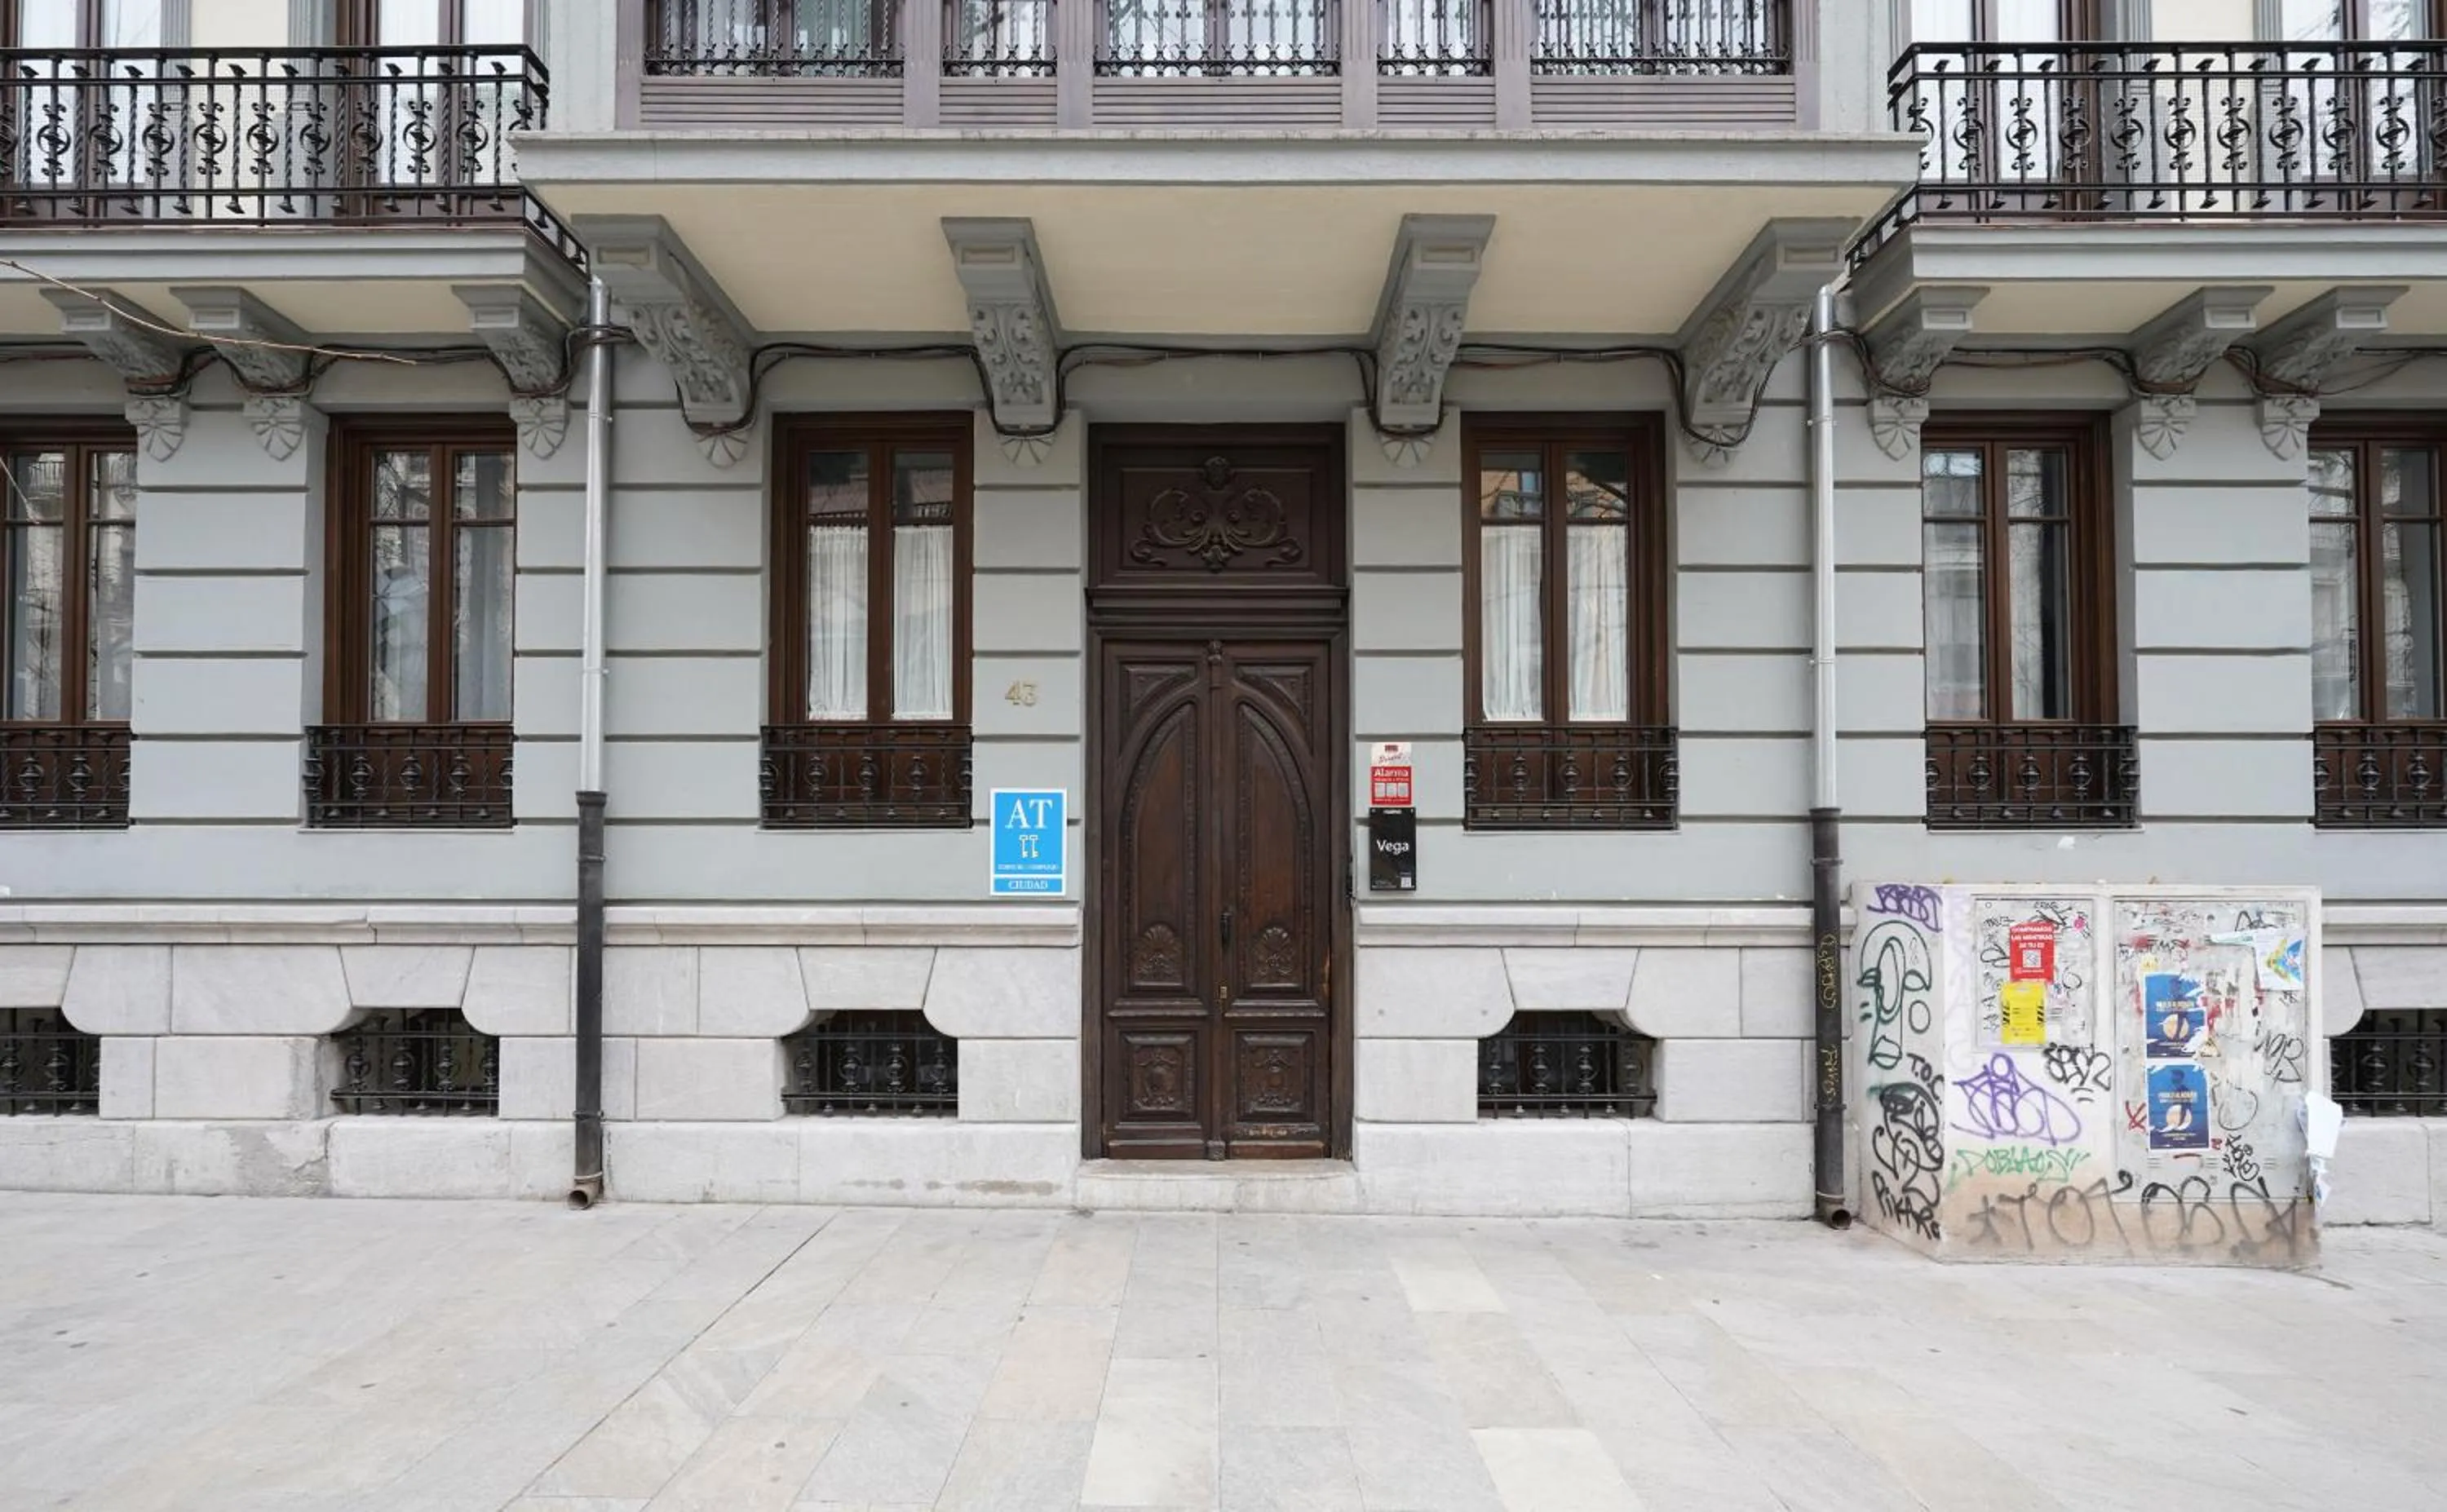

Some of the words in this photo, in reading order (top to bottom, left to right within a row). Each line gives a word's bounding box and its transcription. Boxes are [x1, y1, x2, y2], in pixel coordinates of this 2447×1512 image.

[1005, 680, 1038, 708] 43
[1374, 768, 1409, 777] Alarma
[1005, 798, 1054, 829] AT
[1376, 839, 1409, 855] Vega
[1007, 880, 1049, 890] CIUDAD
